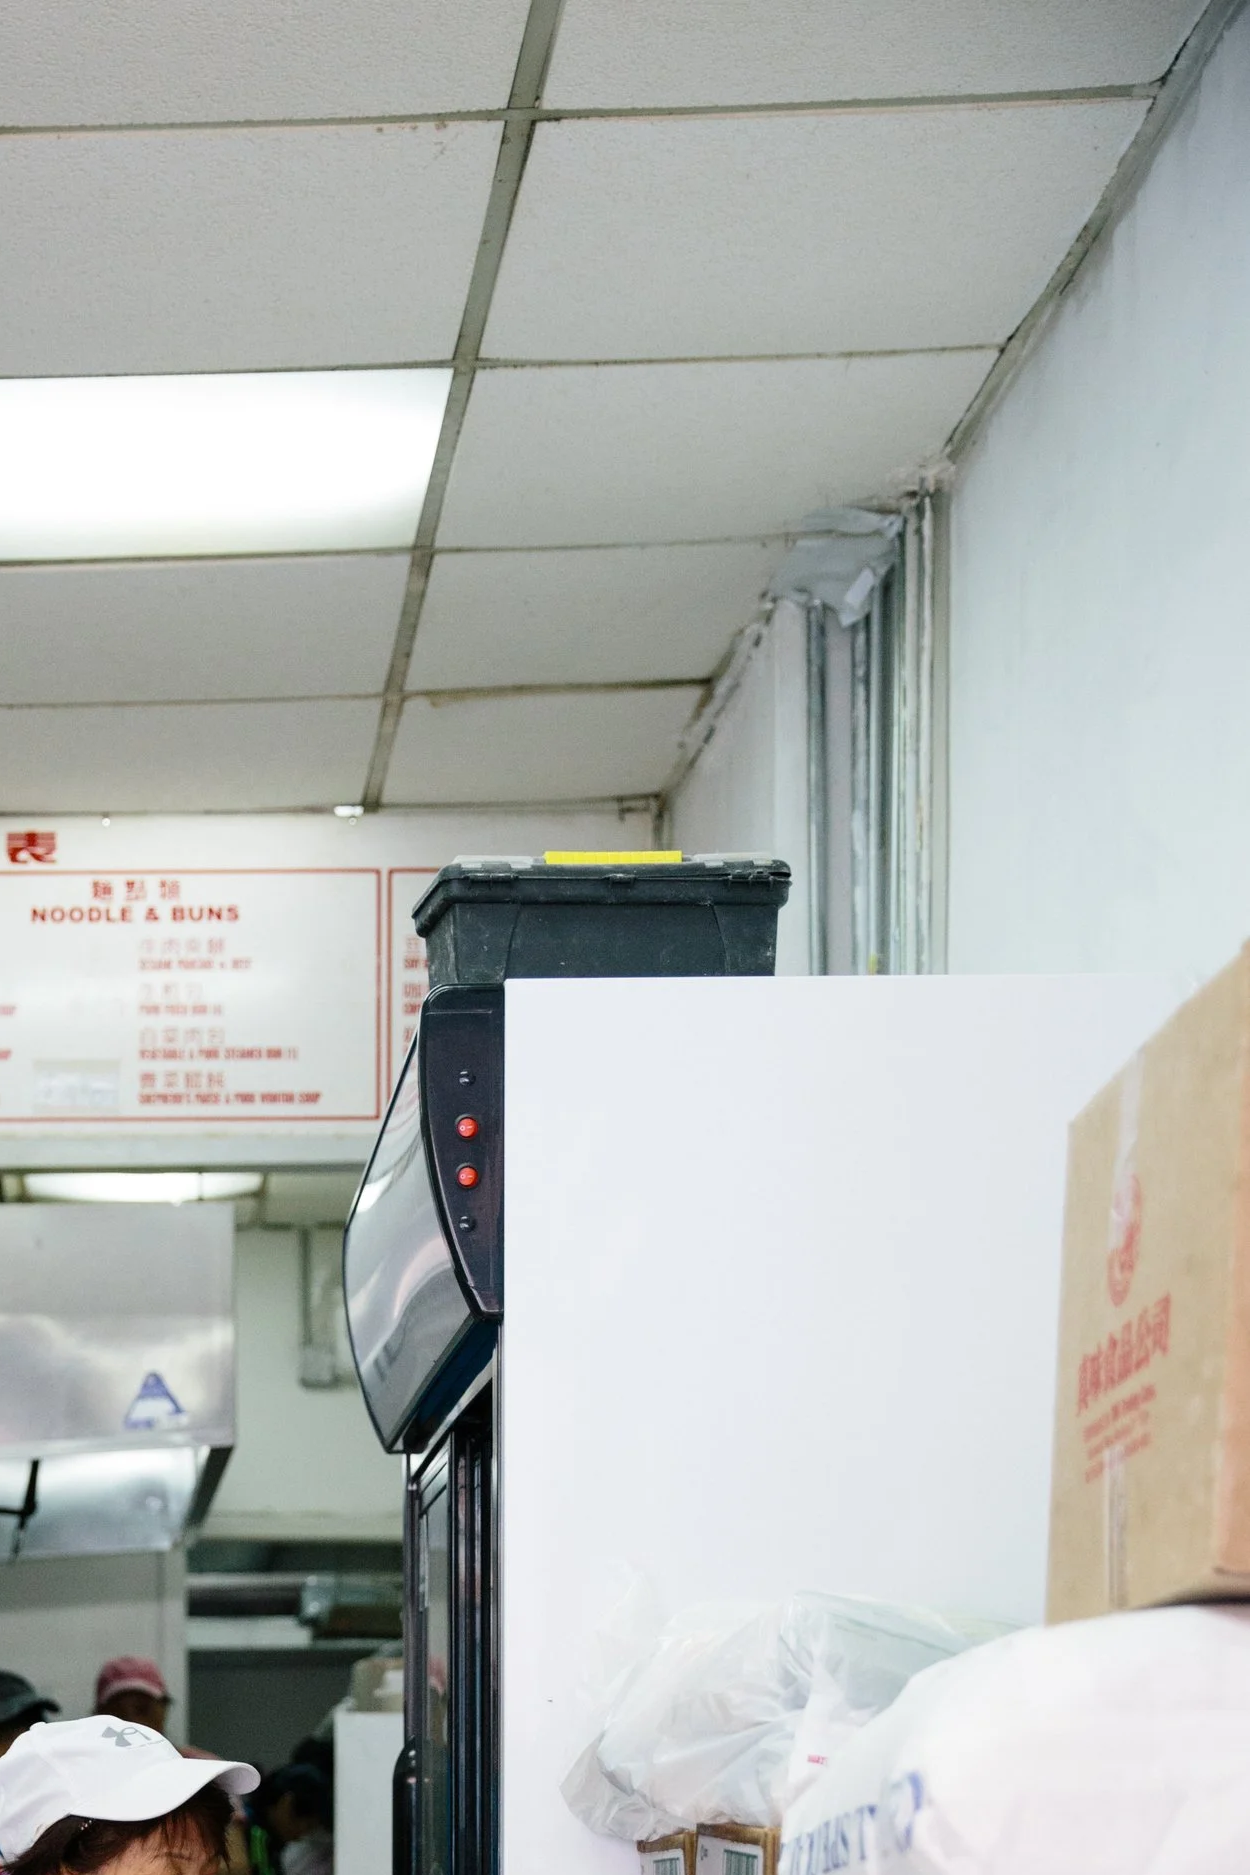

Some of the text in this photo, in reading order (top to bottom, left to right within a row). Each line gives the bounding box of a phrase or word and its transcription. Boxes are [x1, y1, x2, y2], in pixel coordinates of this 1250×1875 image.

[31, 905, 240, 923] NOODLE & BUNS
